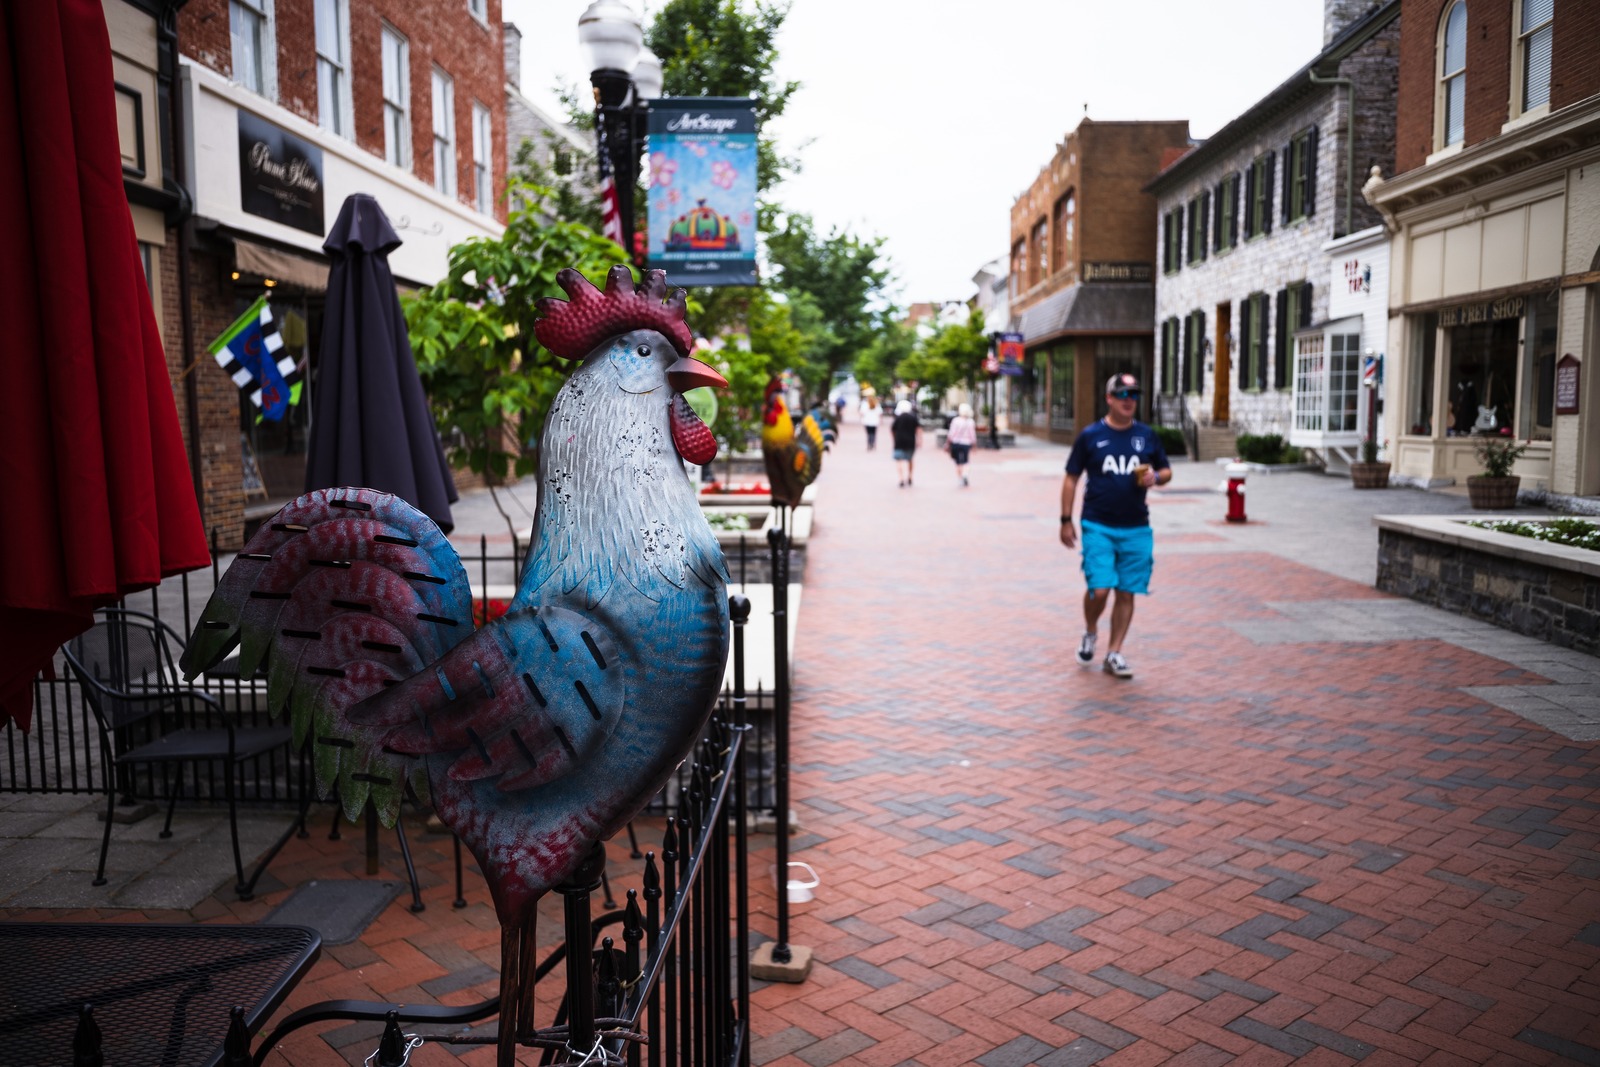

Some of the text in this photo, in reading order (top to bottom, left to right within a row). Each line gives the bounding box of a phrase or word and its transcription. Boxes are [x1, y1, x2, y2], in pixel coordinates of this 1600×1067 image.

[666, 112, 737, 134] ArtScape
[1438, 297, 1524, 327] THE FRET SHOP
[1102, 454, 1141, 475] AIA
